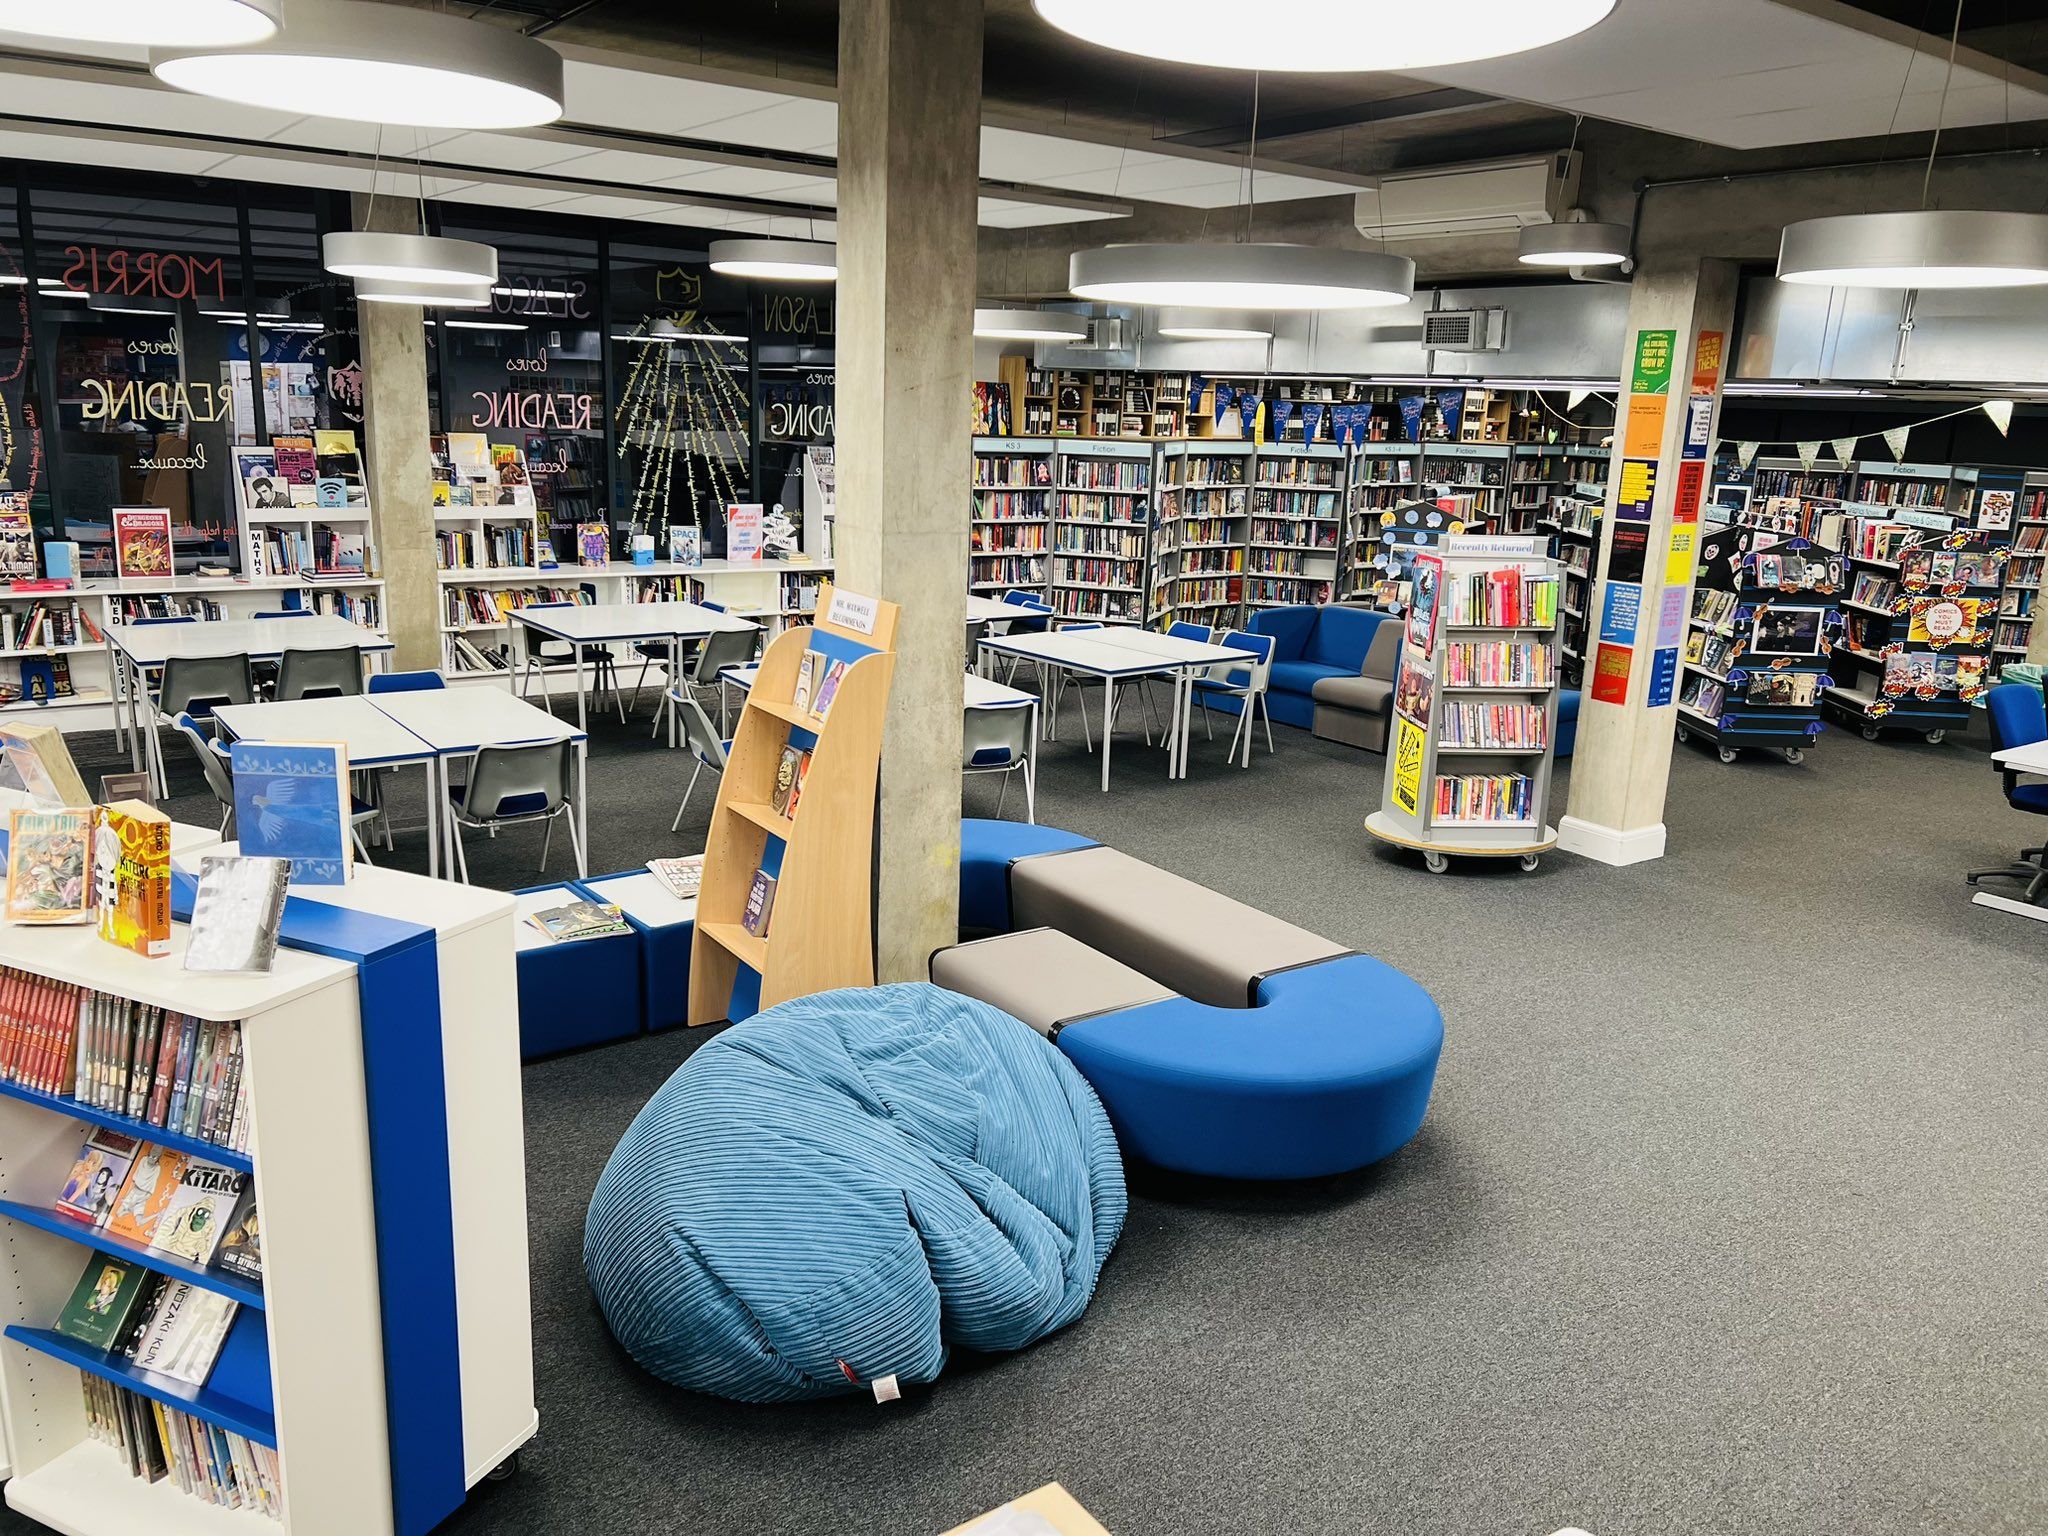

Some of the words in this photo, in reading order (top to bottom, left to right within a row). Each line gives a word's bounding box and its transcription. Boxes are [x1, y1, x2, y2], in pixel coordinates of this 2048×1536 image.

[1642, 348, 1657, 357] EXCEPT
[1640, 358, 1657, 368] GROW
[1092, 444, 1116, 452] Fiction
[1290, 446, 1313, 454] Fiction
[279, 455, 300, 463] EPICS
[1893, 466, 1916, 474] Fiction
[672, 529, 698, 539] SPACE
[1450, 542, 1488, 552] Recently
[1490, 543, 1533, 553] Returned
[251, 533, 262, 576] MATHS
